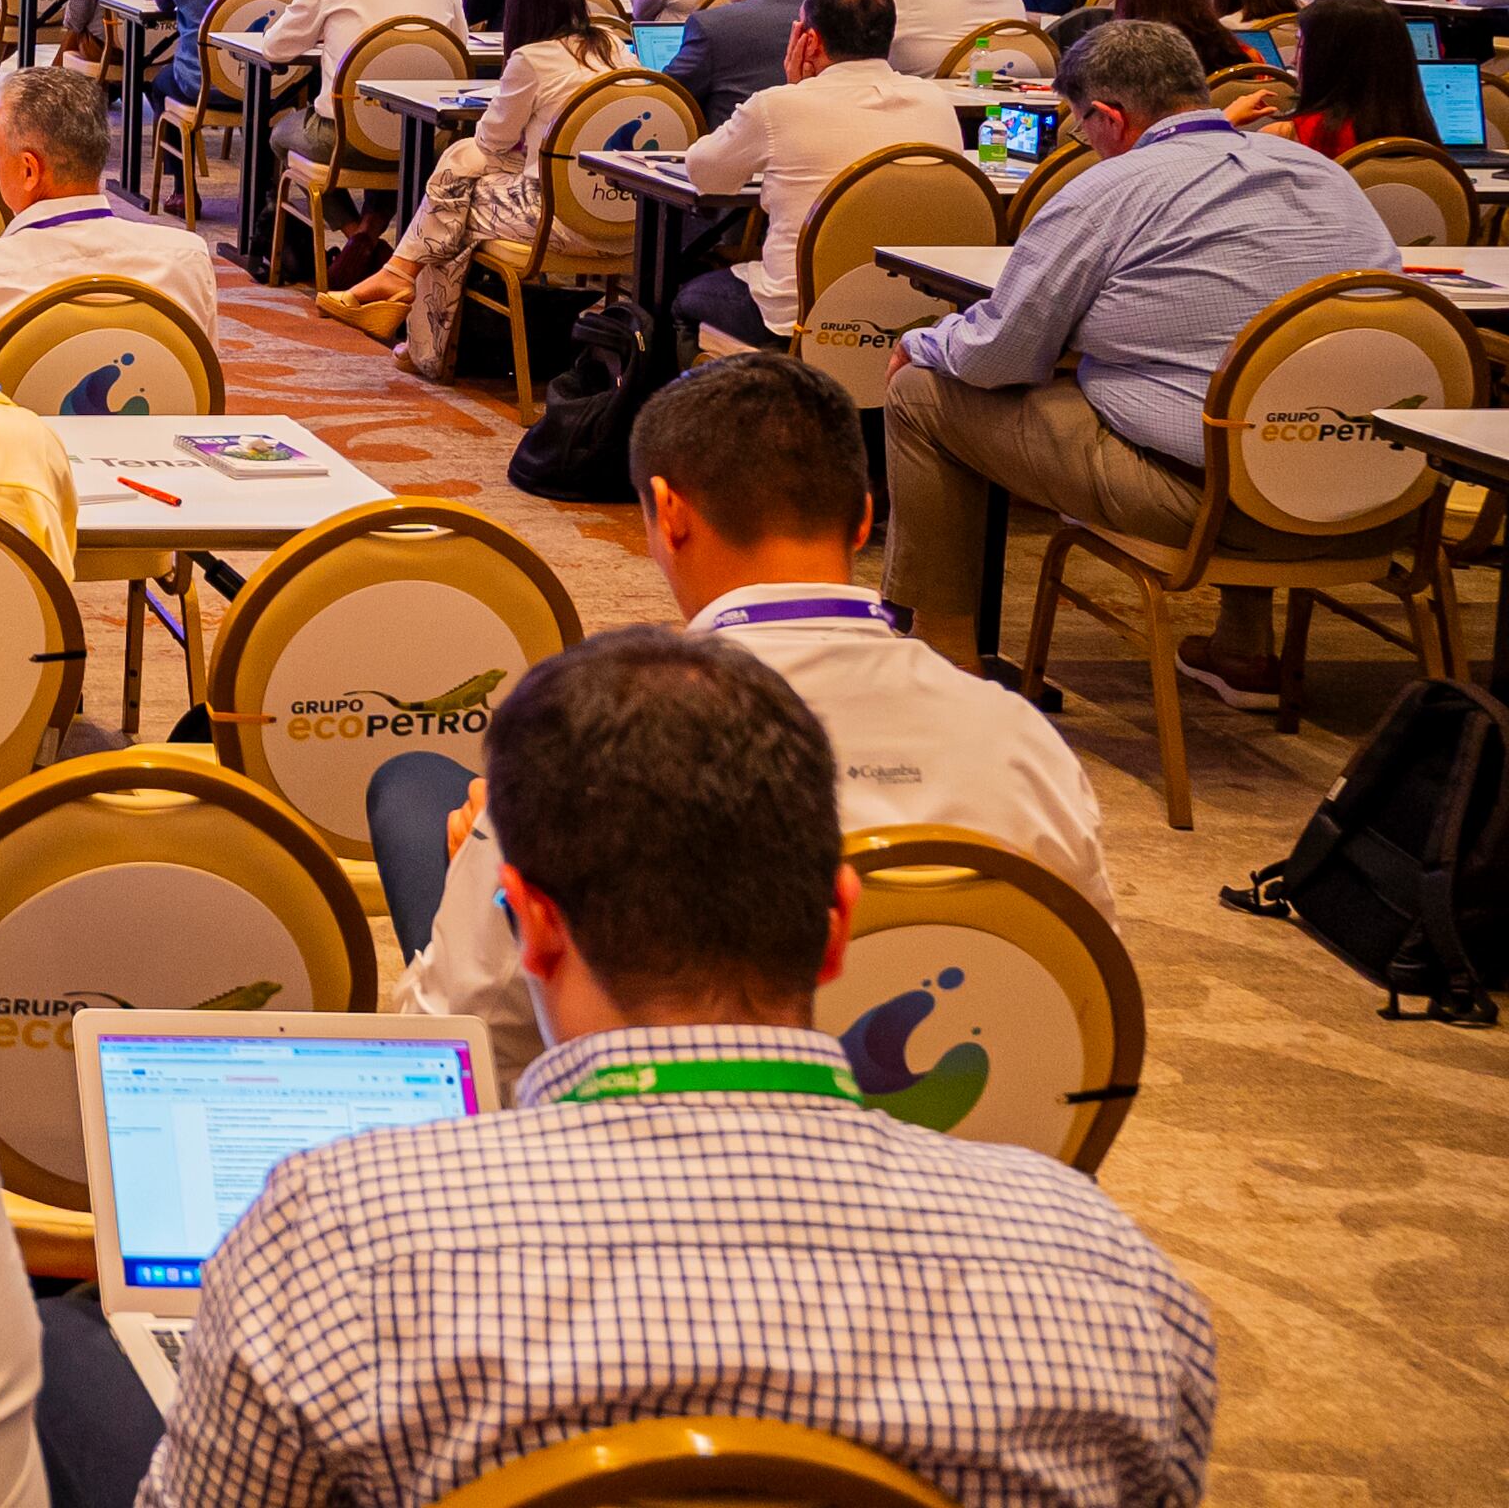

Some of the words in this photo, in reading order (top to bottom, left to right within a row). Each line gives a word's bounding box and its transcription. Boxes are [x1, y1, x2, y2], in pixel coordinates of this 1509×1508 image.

[821, 322, 860, 332] GRUPO
[1266, 412, 1320, 423] GRUPO
[291, 699, 364, 714] GRUPO
